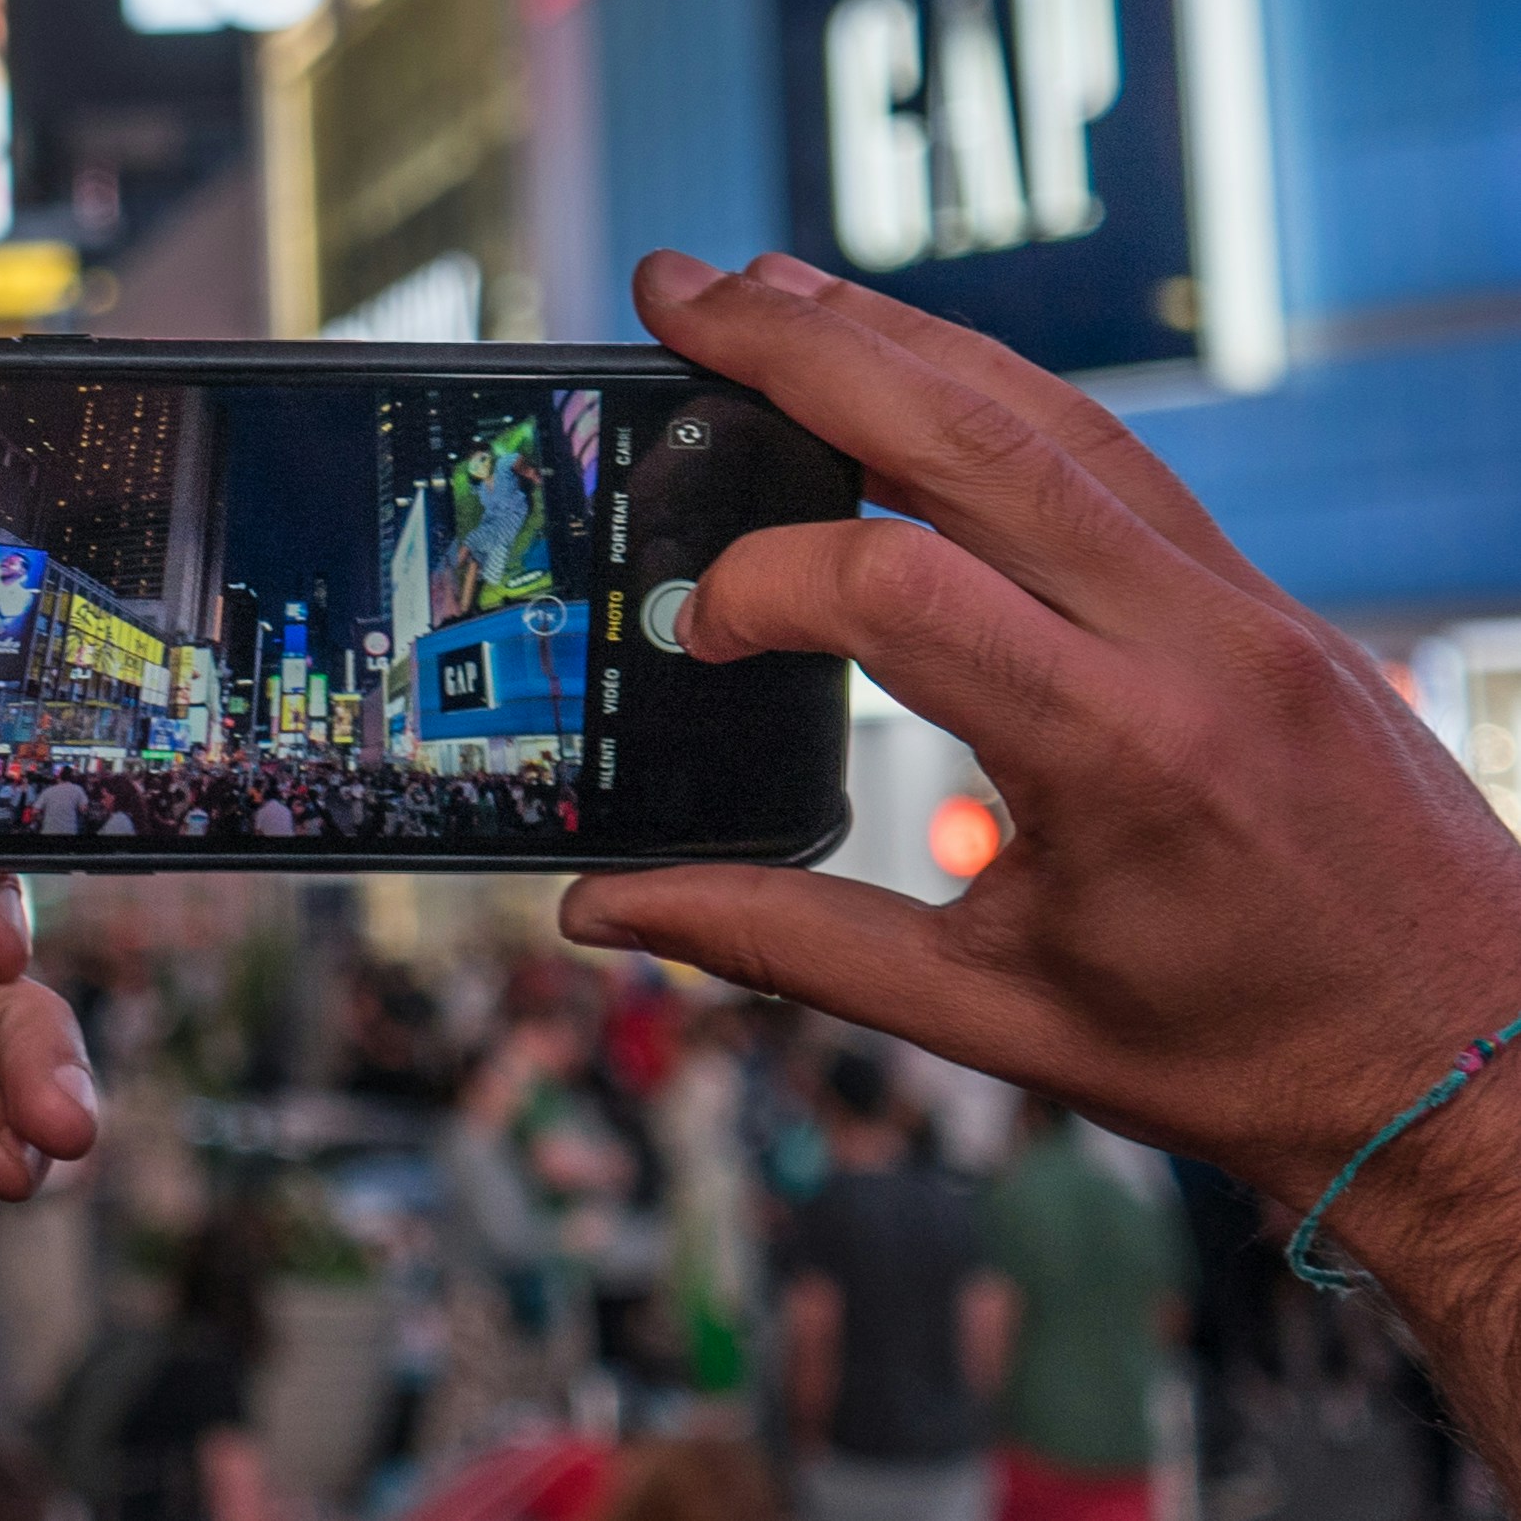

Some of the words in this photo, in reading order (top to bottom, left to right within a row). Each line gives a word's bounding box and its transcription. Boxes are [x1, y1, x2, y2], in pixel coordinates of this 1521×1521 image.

[610, 491, 630, 564] PORTRAIT
[606, 590, 624, 642] PHOTO
[443, 661, 479, 697] GAP
[600, 667, 621, 715] VIDÉO
[598, 737, 617, 790] RALENTI
